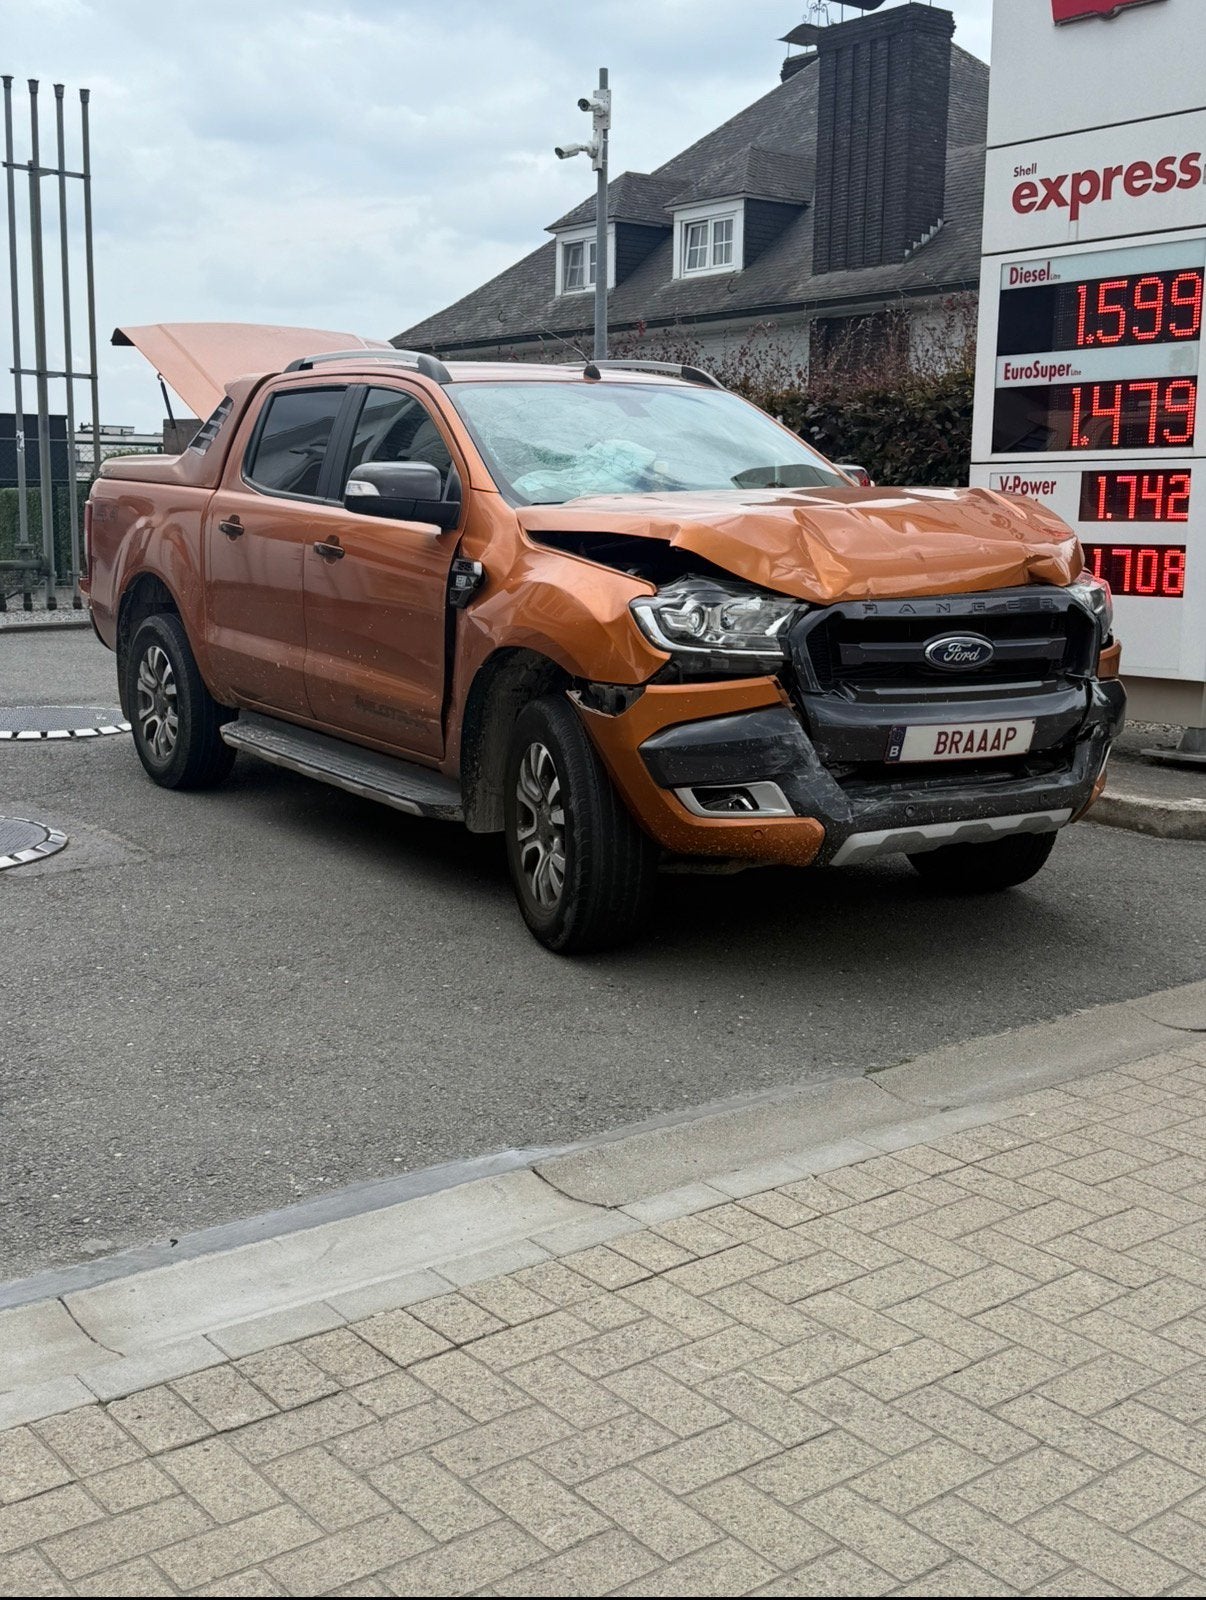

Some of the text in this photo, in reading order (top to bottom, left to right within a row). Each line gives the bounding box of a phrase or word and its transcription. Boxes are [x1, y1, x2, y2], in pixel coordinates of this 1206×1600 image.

[1013, 163, 1037, 178] Shell
[1012, 152, 1202, 221] express
[1009, 261, 1051, 285] Diesel
[1077, 272, 1202, 346] 1.599
[1004, 360, 1072, 382] EuroSuper
[1072, 380, 1196, 447] 1.479
[999, 475, 1057, 495] V-Power
[1097, 474, 1191, 520] 1.742
[862, 597, 1054, 614] RANGER
[943, 642, 982, 661] Ford
[889, 746, 899, 757] B
[933, 727, 1017, 755] BRAAAP
